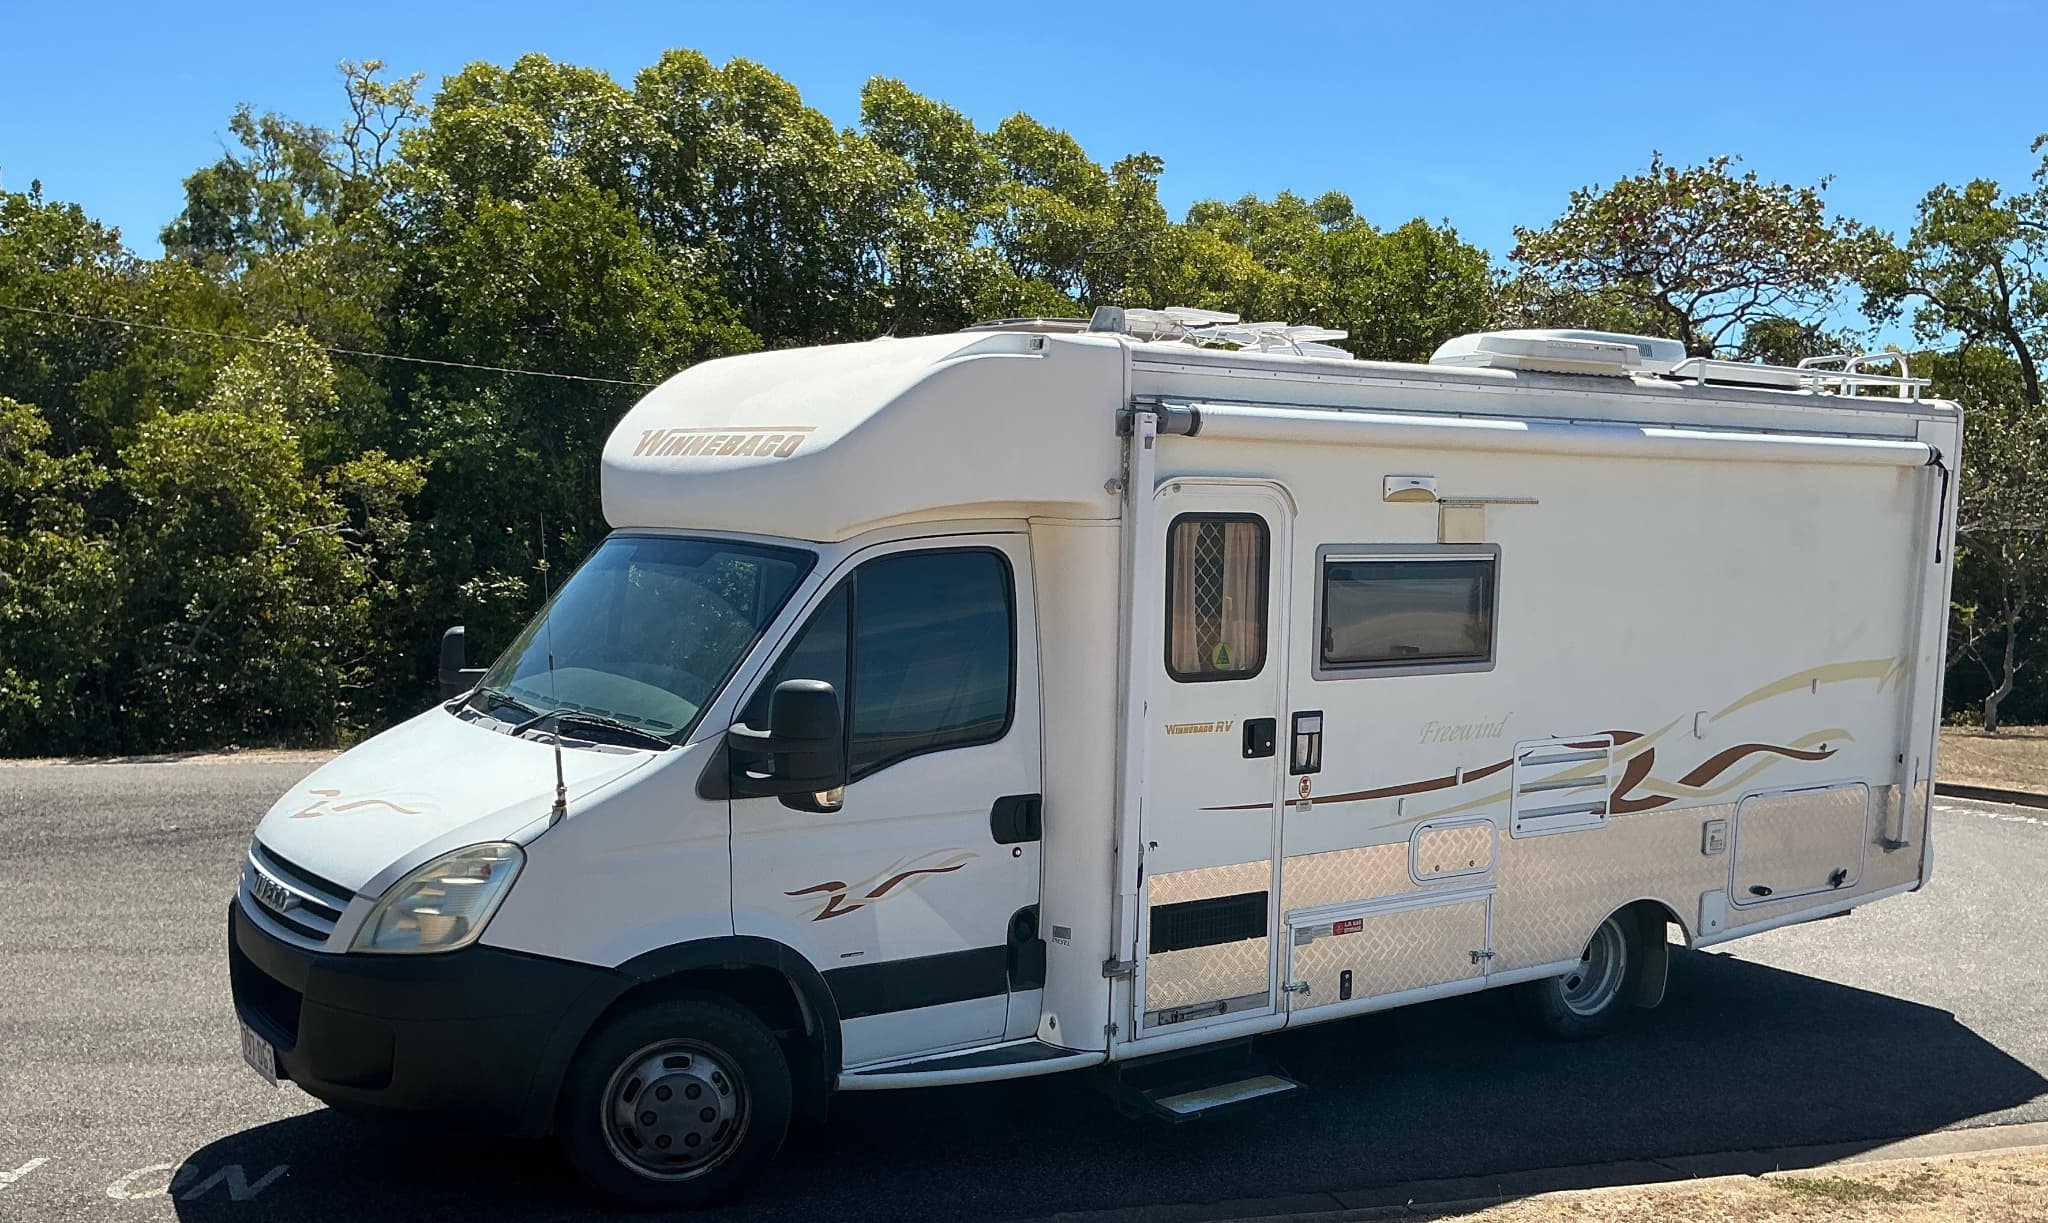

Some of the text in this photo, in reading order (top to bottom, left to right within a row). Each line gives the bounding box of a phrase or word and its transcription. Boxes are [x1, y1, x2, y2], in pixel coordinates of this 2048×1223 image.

[633, 427, 807, 458] WINNEBAGO
[1164, 720, 1233, 735] WINNEBAGO RV
[1417, 711, 1510, 744] Freewind
